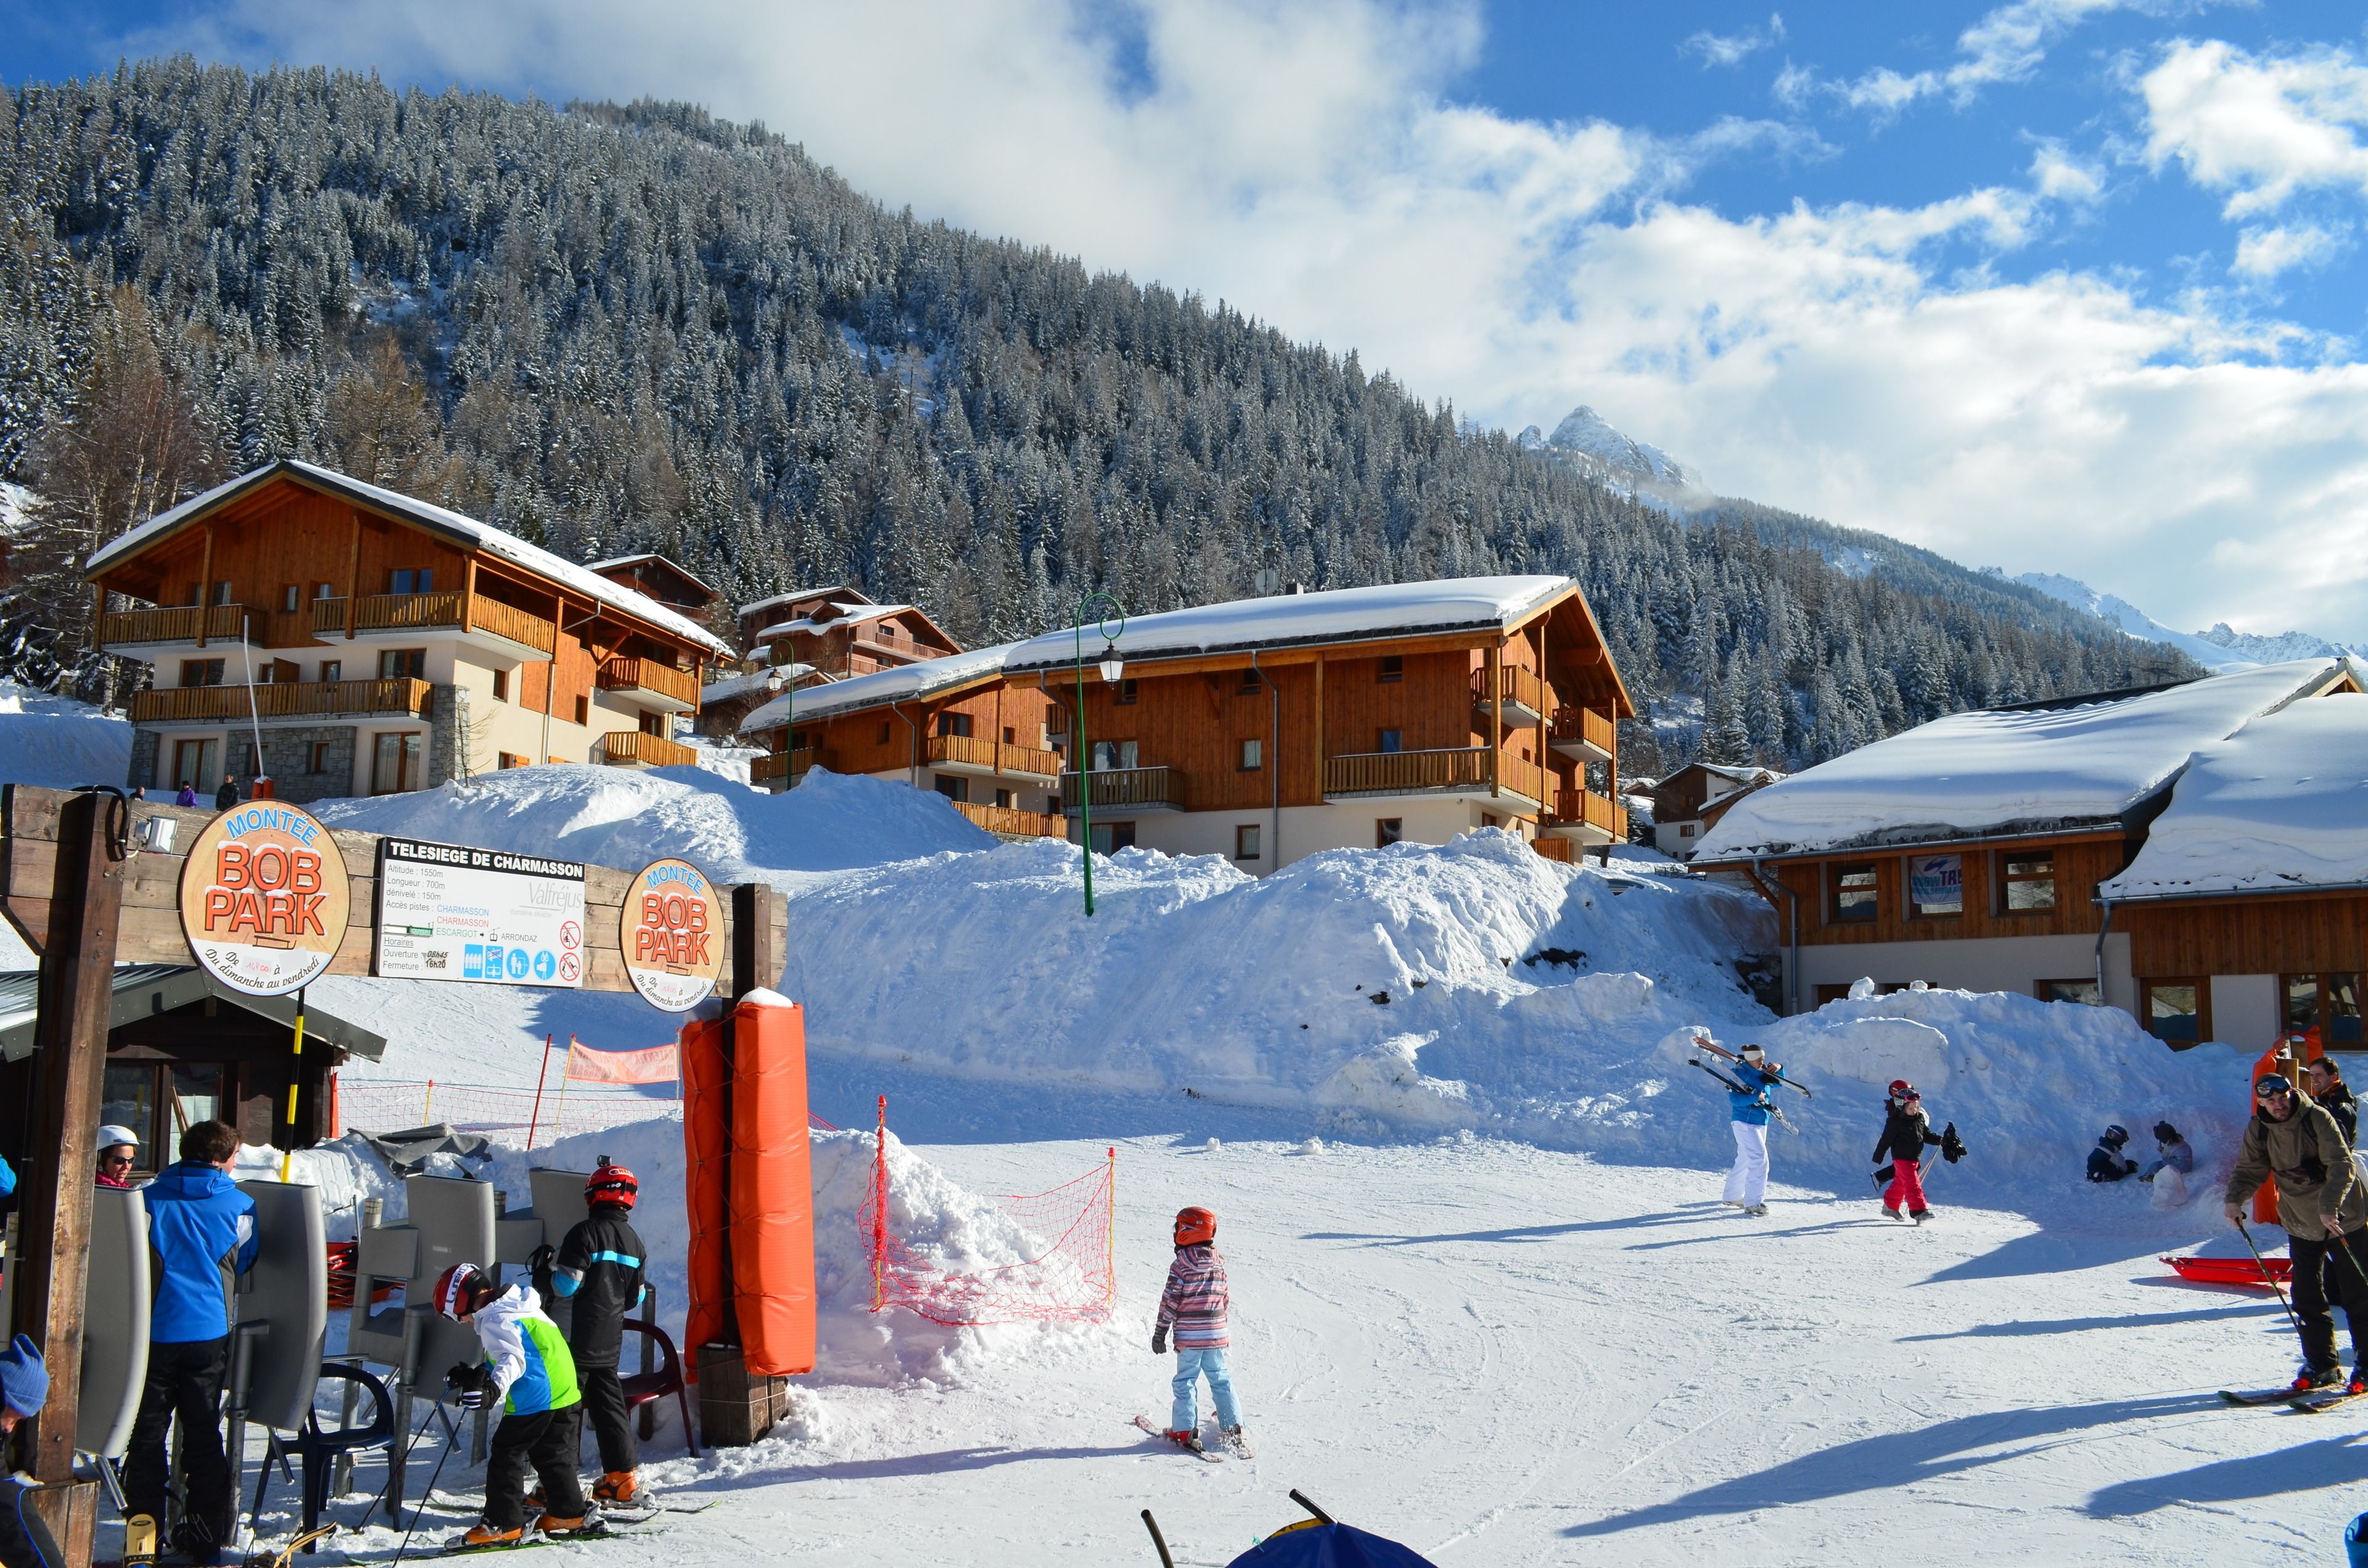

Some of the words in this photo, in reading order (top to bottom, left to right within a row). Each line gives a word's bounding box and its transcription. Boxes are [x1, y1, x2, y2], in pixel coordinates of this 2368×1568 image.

[226, 808, 319, 847] MONTÉE
[216, 841, 321, 894] BOB
[388, 864, 414, 874] Altitude
[421, 868, 443, 878] 1550m
[390, 842, 468, 864] TELESIEGE
[472, 852, 490, 866] DE
[493, 855, 583, 877] CHARMASSON
[387, 876, 420, 887] Longueur
[427, 880, 445, 889] 700m
[646, 866, 705, 894] MONTÉE
[386, 889, 416, 898] dénivelé
[423, 892, 441, 900] 150m
[529, 882, 582, 914] Valfréjus
[205, 886, 329, 936] PARK
[386, 900, 408, 909] Accès
[409, 903, 430, 911] pistes
[437, 905, 489, 916] CHARMASSON
[642, 890, 707, 933] BOB
[437, 916, 489, 927] CHARMASSON
[384, 937, 414, 946] Horaires
[436, 927, 478, 938] ESCARGOT
[501, 933, 538, 942] ARRONDAZ
[636, 925, 712, 966] PARK
[225, 951, 239, 966] De
[273, 965, 281, 975] à
[383, 961, 419, 971] Fermeture
[384, 949, 419, 958] Ouverture
[427, 950, 448, 959] 08h45
[205, 949, 220, 966] Du
[218, 965, 265, 988] dimanche
[282, 955, 319, 986] vendredi
[637, 974, 646, 987] Du
[646, 987, 673, 1006] dimanche
[684, 980, 707, 1004] vendredi
[649, 977, 658, 988] De
